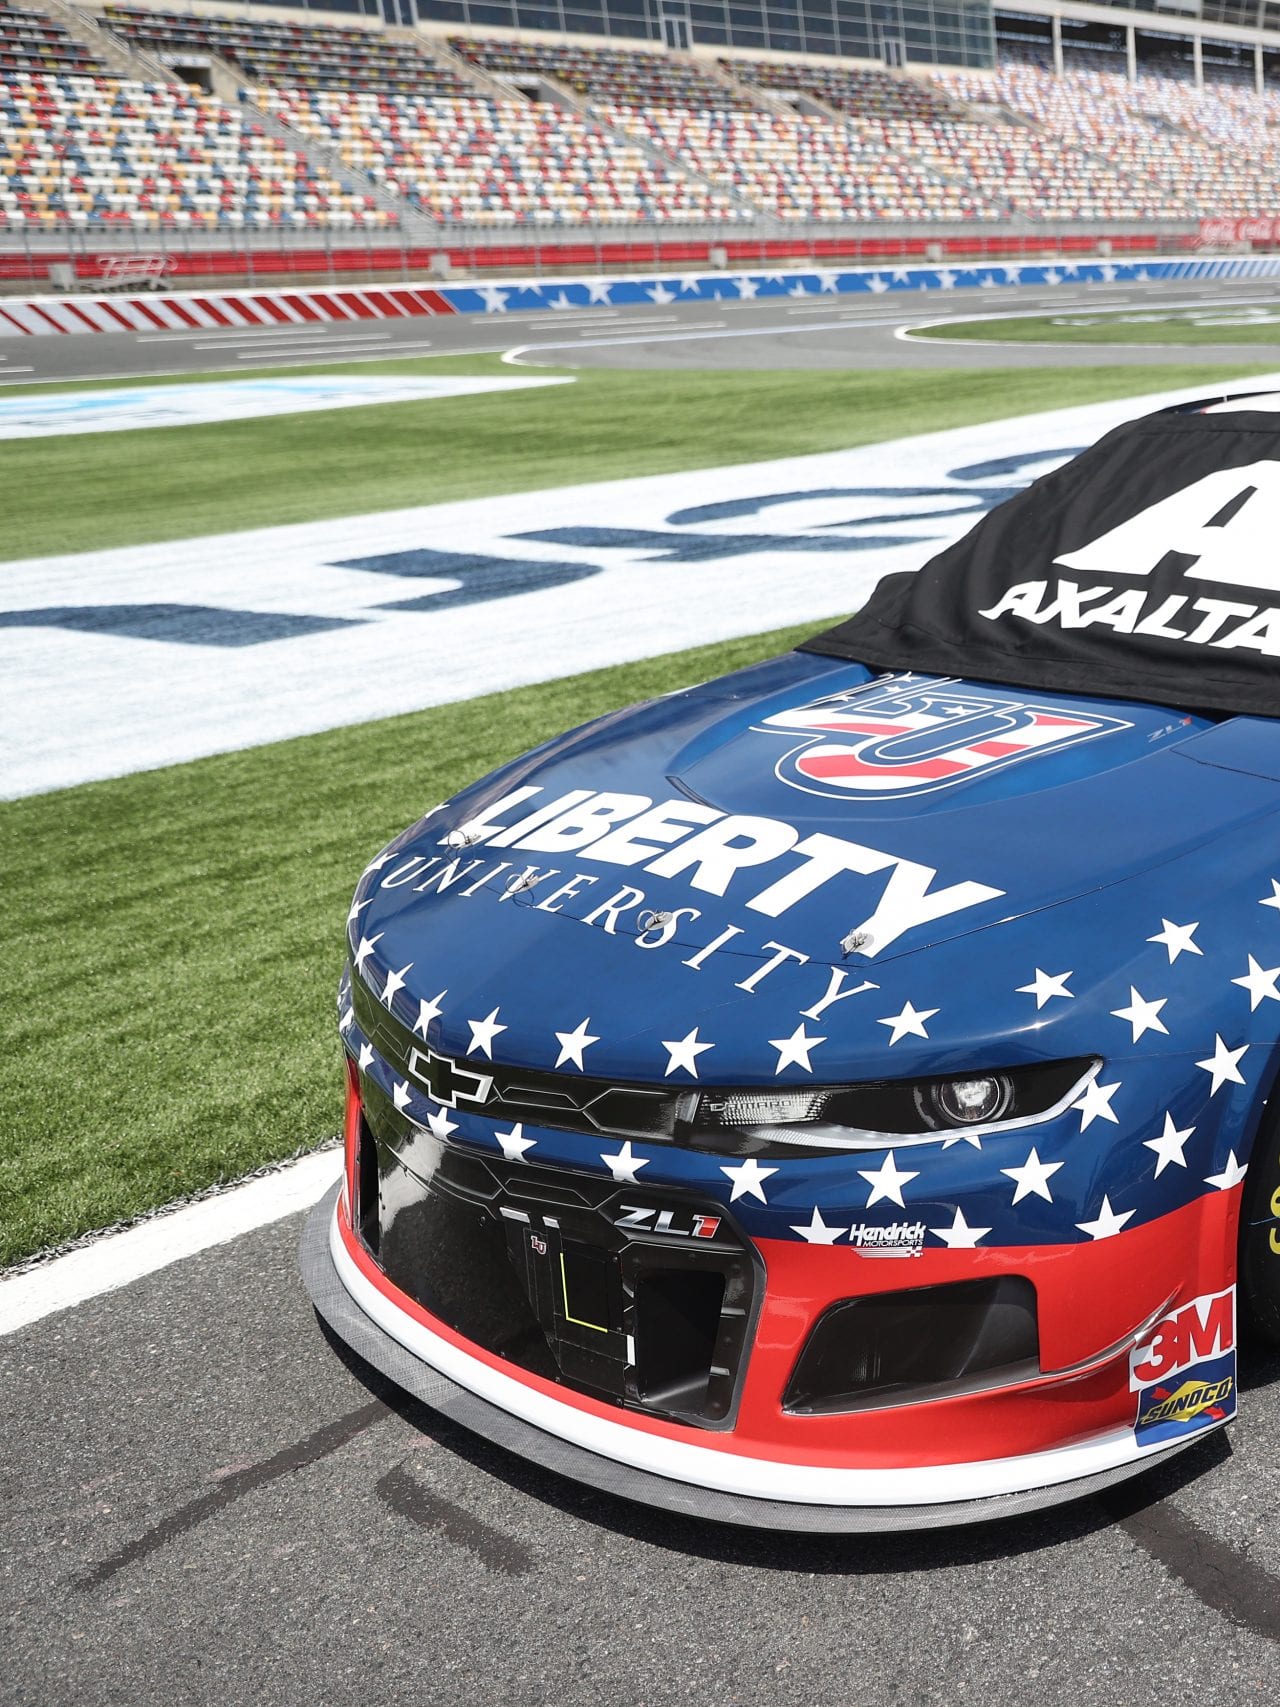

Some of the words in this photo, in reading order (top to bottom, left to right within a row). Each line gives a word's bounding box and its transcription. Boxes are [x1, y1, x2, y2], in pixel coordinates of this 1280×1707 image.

[437, 786, 1006, 958] LIBERTY
[379, 855, 880, 1021] UNIVERSITY
[613, 1205, 722, 1238] ZL1
[849, 1222, 926, 1247] Hendrick
[1133, 1290, 1233, 1381] 3M
[1145, 1379, 1231, 1423] SUNOCO
